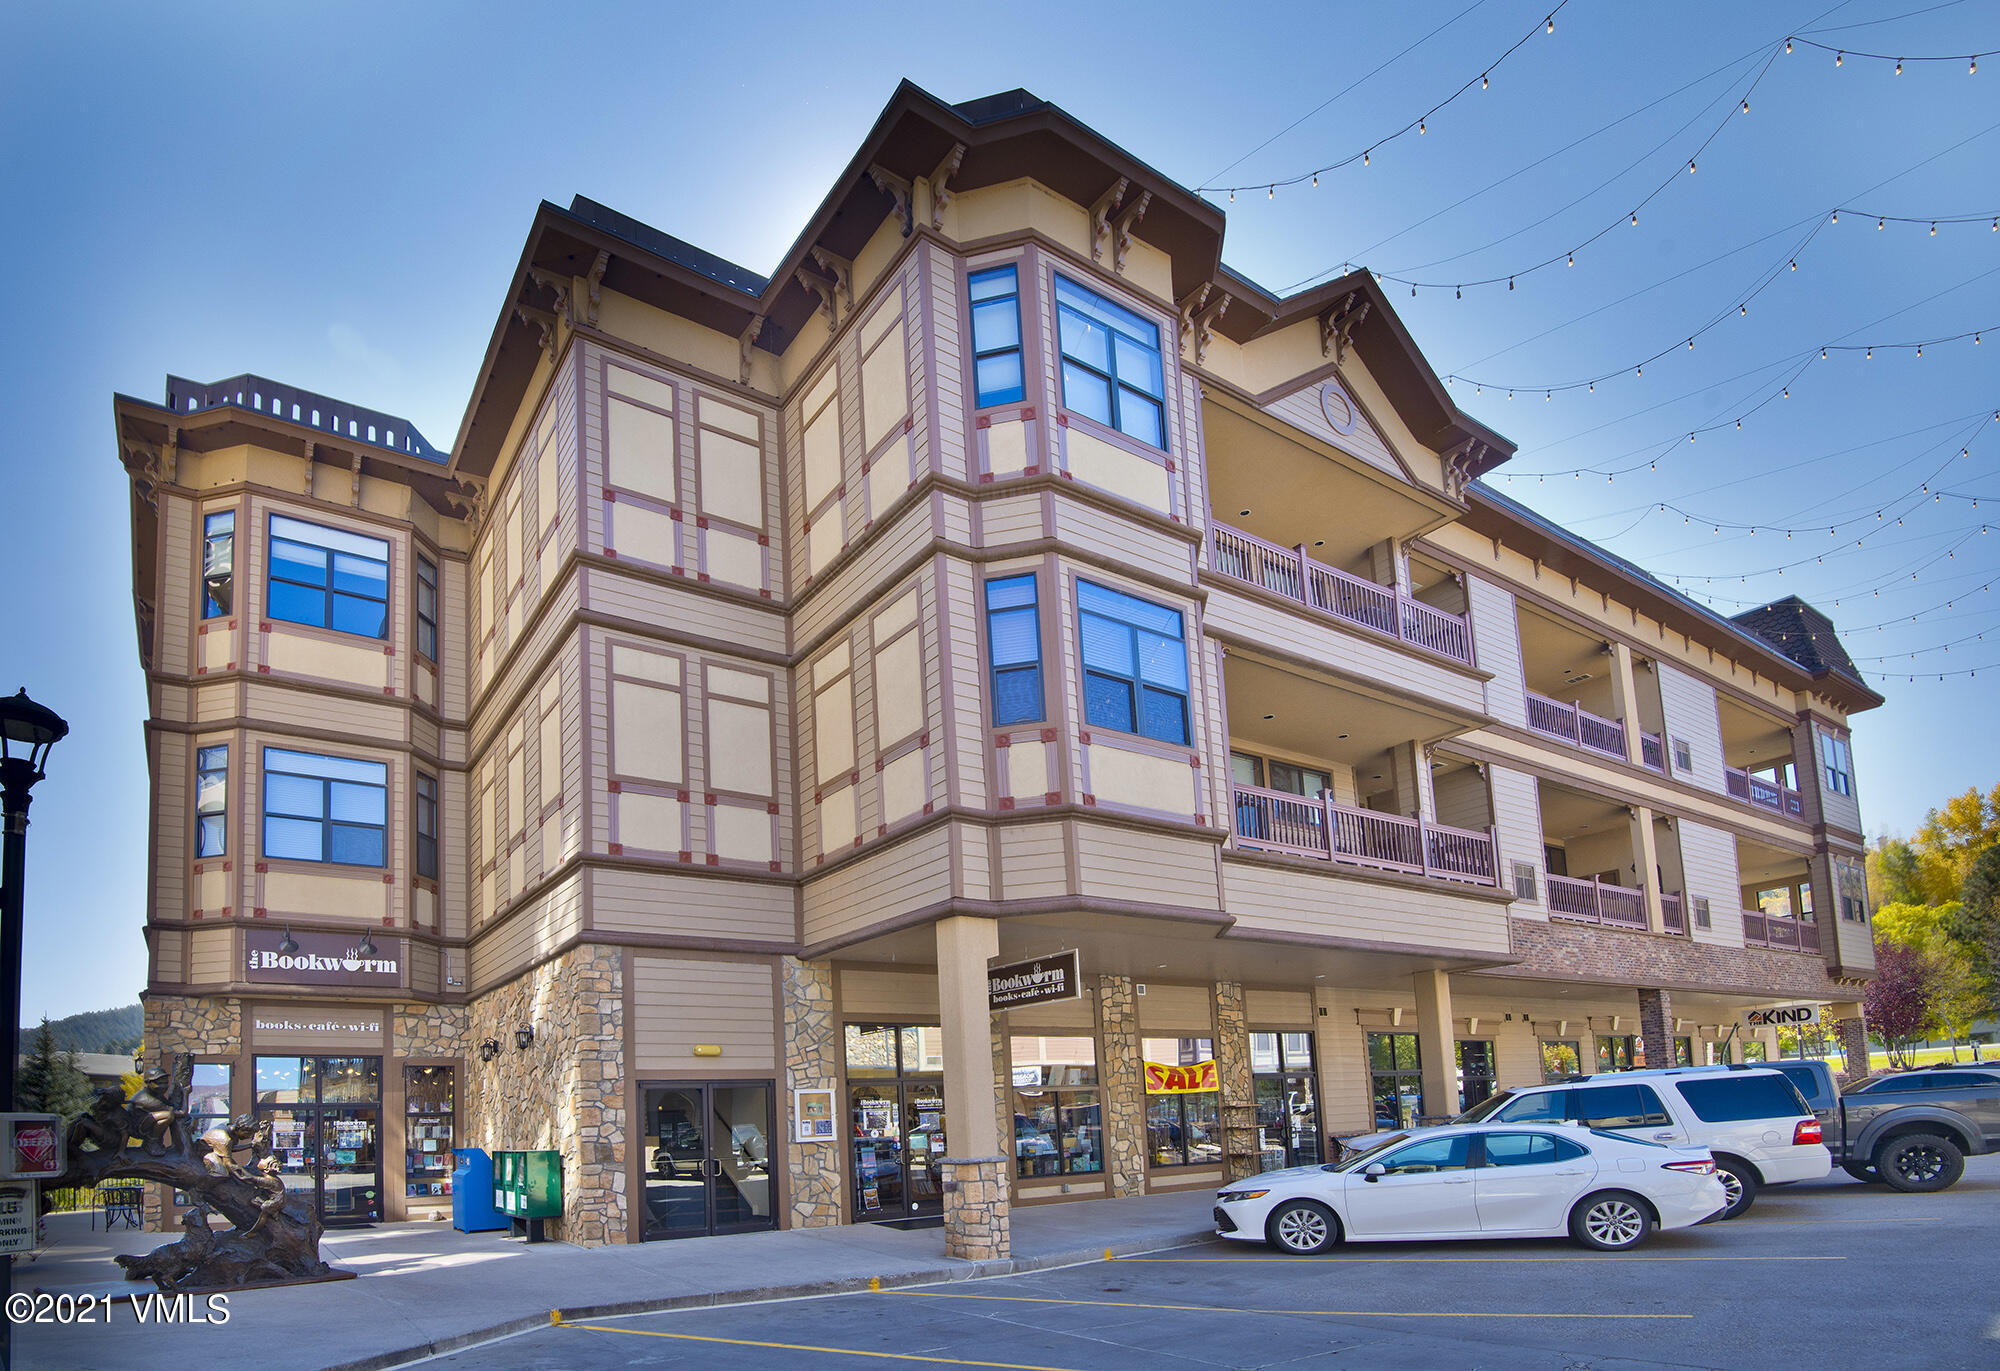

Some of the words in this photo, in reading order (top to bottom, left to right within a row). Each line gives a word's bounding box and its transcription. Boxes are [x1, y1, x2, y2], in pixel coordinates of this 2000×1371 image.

[249, 950, 259, 969] the
[993, 992, 1019, 1003] books
[1762, 1007, 1812, 1025] KIND
[255, 1019, 301, 1030] books
[308, 1022, 339, 1031] café
[349, 1022, 380, 1032] wi-fi
[1146, 1064, 1217, 1091] SALE
[0, 1227, 27, 1236] RKING
